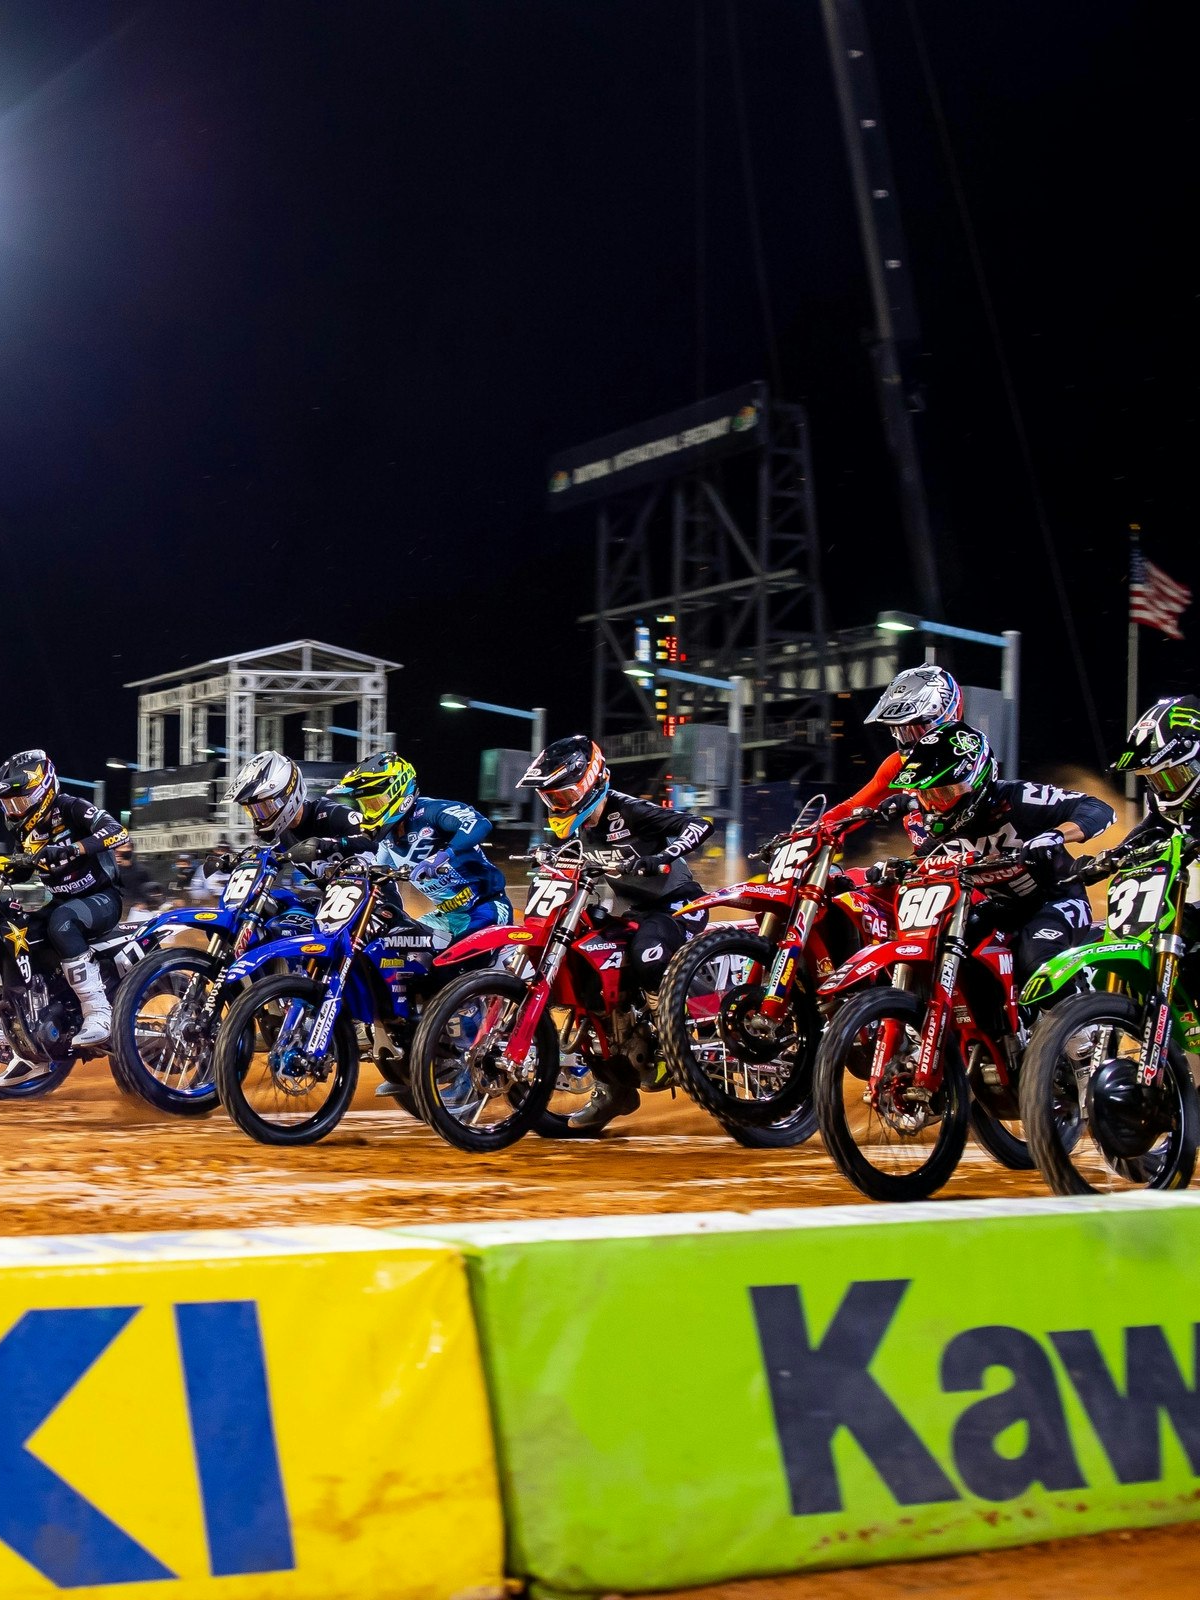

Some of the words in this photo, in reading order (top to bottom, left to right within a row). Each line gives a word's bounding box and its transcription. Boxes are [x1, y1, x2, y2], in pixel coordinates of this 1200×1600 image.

[387, 766, 417, 799] 100%
[581, 755, 606, 795] 100%
[768, 837, 814, 884] 45
[971, 864, 1023, 884] MOTUL
[224, 868, 257, 903] 66
[315, 884, 363, 921] 26
[525, 879, 573, 918] 75
[1108, 874, 1167, 931] 31
[862, 914, 887, 938] GAS
[898, 884, 951, 931] 60
[384, 935, 432, 948] MANLUK
[586, 942, 617, 952] GASGAS
[772, 951, 787, 988] DUNLOP
[319, 1003, 338, 1052] DUNLOP
[1154, 1004, 1169, 1045] BRAKING
[920, 1016, 938, 1074] DUNLOP
[1136, 1016, 1152, 1084] DUNLOP
[749, 1279, 1200, 1515] Kaw
